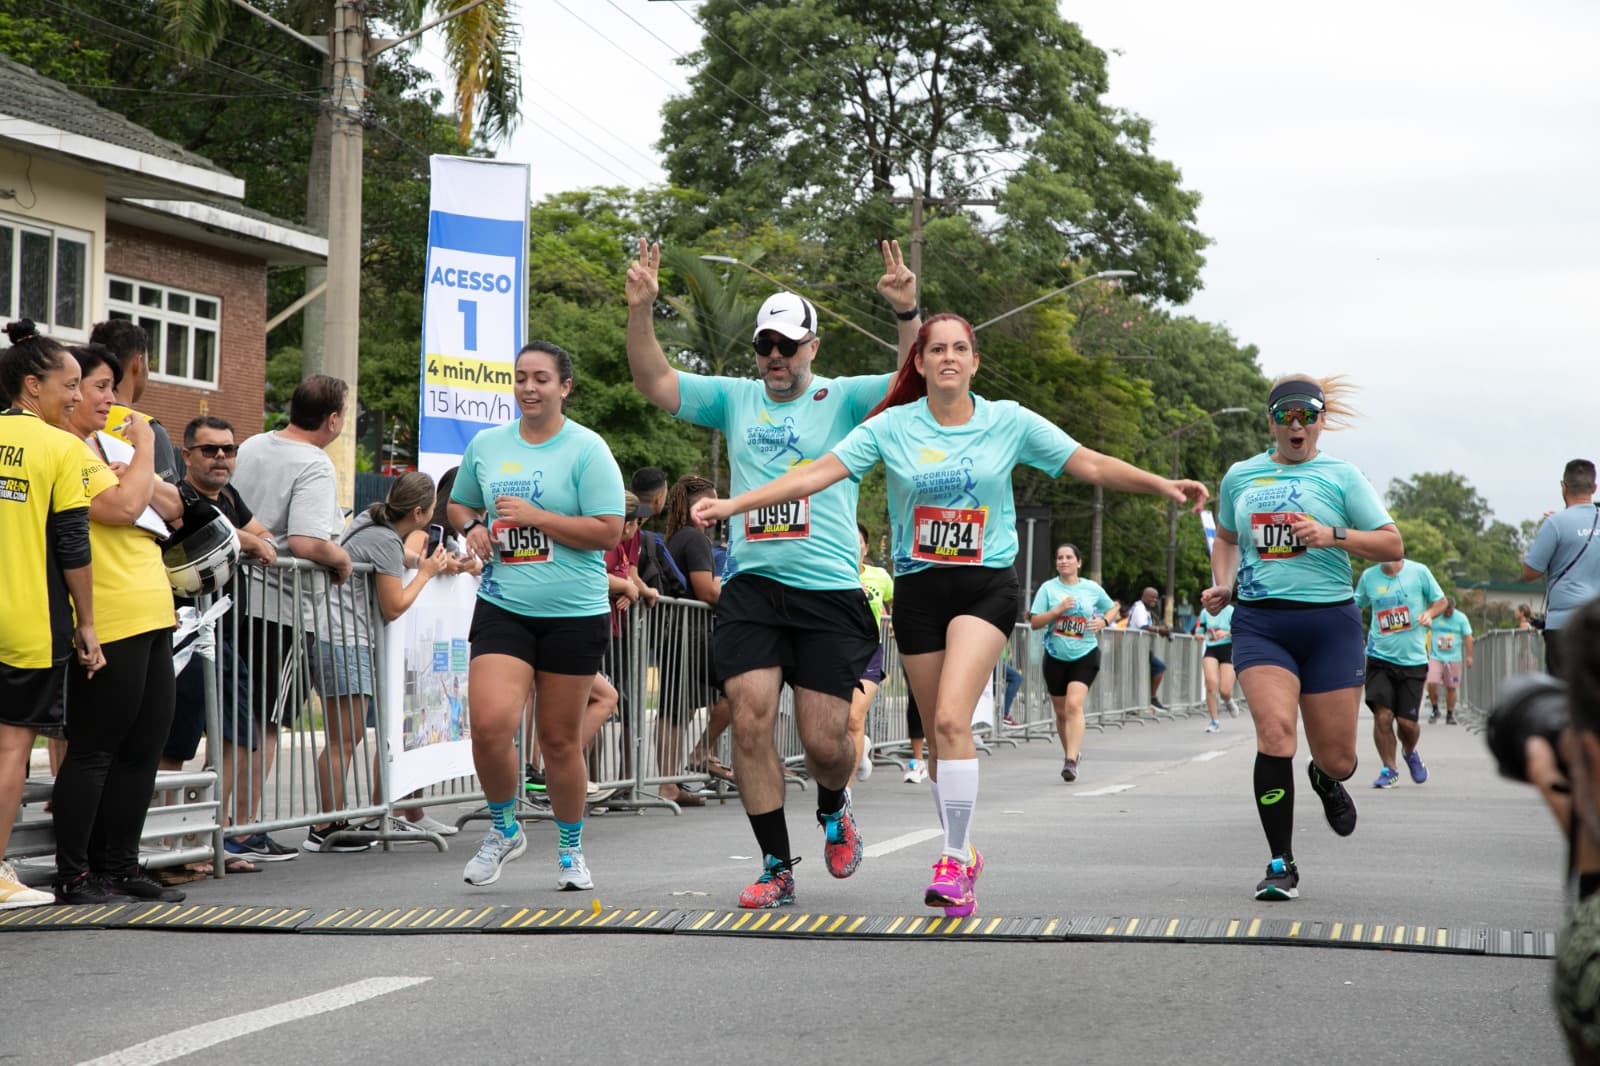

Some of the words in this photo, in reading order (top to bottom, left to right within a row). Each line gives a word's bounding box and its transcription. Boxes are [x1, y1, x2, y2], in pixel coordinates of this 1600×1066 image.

[431, 266, 511, 294] ACESSO
[458, 299, 477, 351] 1
[428, 359, 439, 376] 4
[443, 362, 512, 385] min/km
[429, 390, 449, 413] 15
[455, 392, 511, 421] km/h
[758, 501, 800, 525] 0997
[930, 520, 973, 549] 0734
